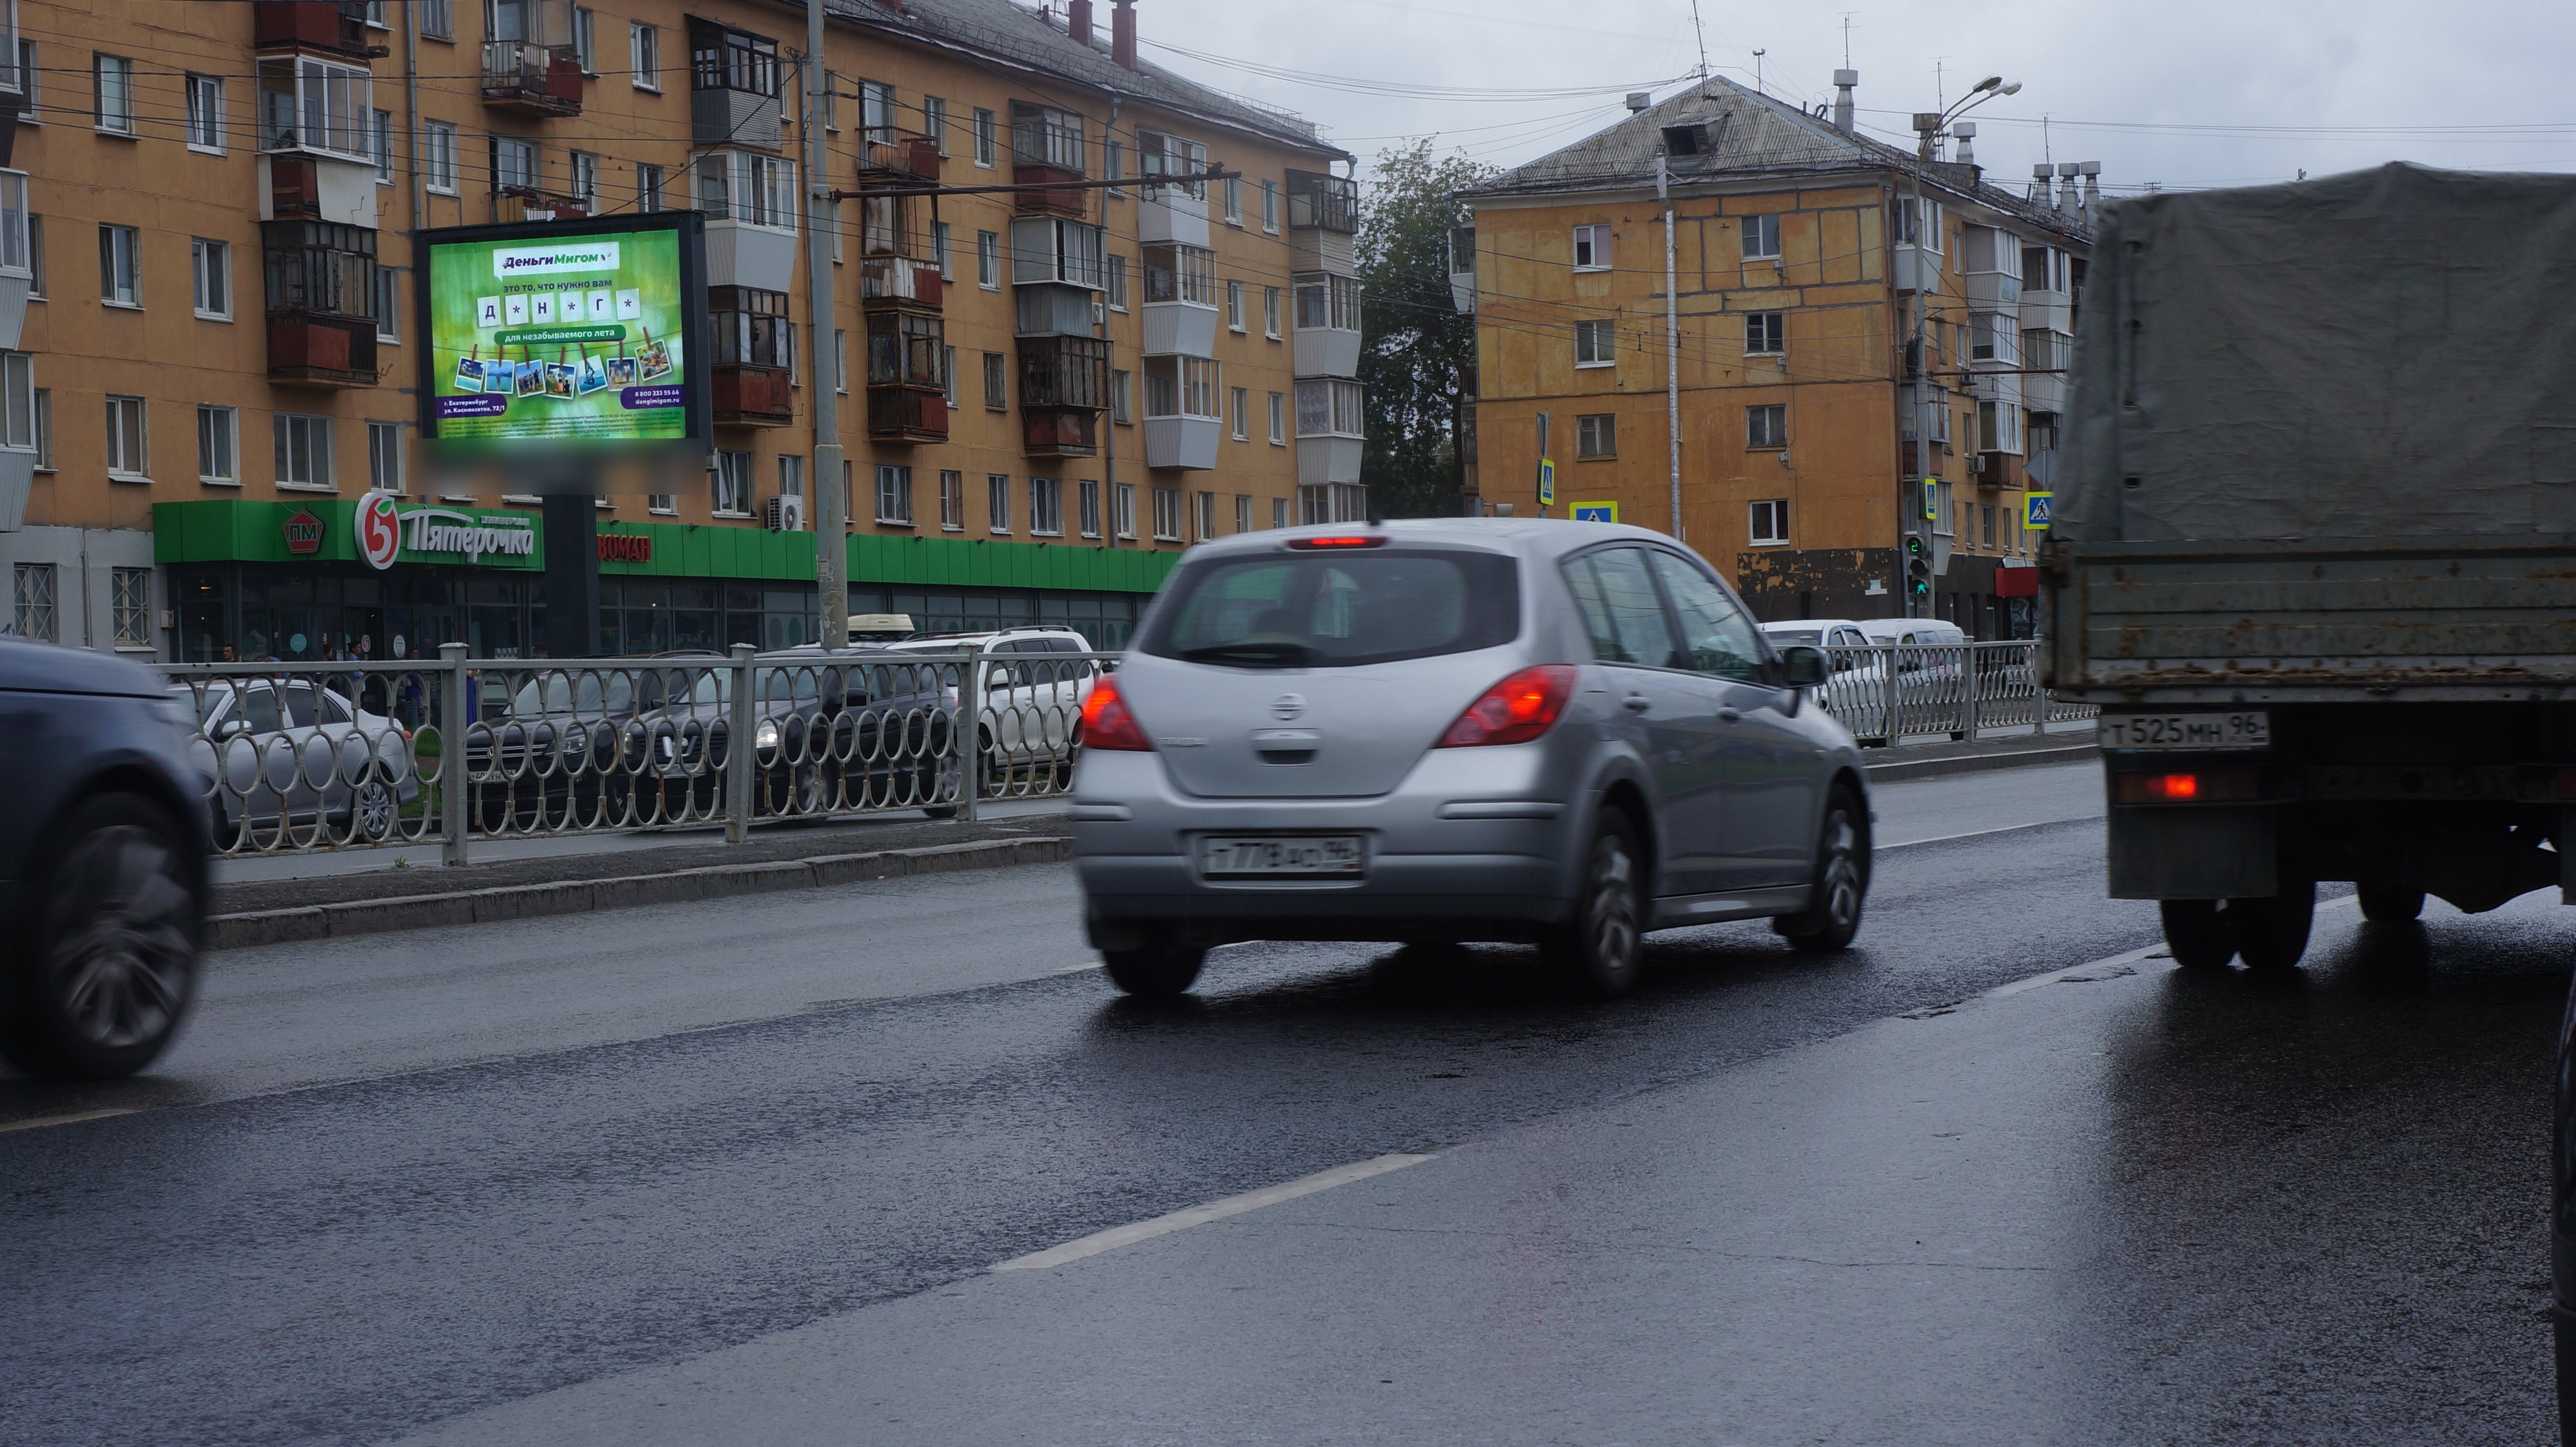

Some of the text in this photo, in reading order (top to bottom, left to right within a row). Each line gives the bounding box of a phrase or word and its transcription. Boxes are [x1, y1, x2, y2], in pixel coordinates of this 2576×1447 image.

[502, 254, 598, 268] ДеньгиМигом
[557, 280, 590, 291] нужно
[522, 331, 592, 341] незабываемого
[289, 524, 317, 541] ПМ
[399, 509, 534, 563] Пятерочка
[2111, 715, 2257, 744] Т525МН 96
